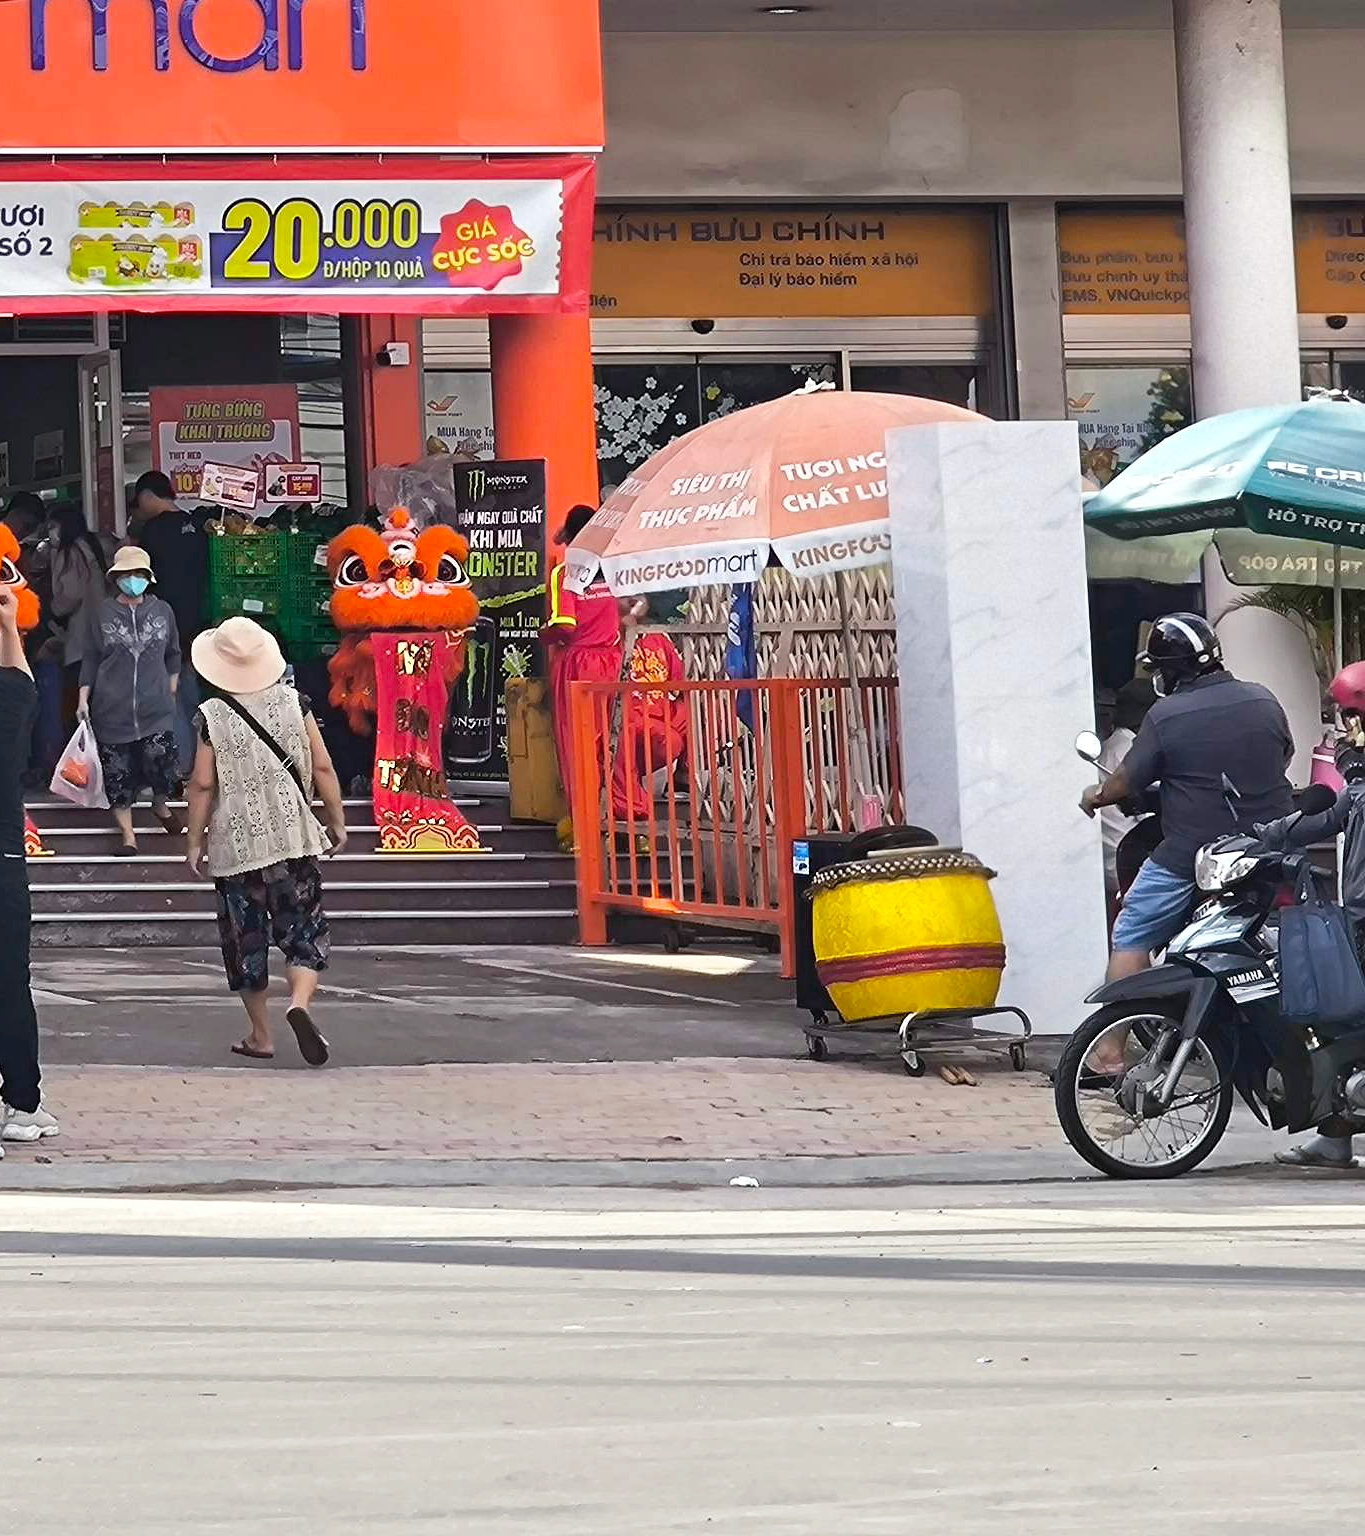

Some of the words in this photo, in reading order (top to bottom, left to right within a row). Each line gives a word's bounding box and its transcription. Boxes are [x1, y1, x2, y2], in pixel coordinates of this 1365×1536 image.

[222, 197, 422, 281] 20.000
[456, 214, 498, 241] GIÁ
[691, 218, 762, 242] BƯU
[772, 213, 885, 241] CHÍNH
[38, 237, 53, 256] 2
[432, 245, 482, 273] CỰC
[484, 236, 536, 263] SỐC
[324, 256, 372, 283] Đ/HỘP
[374, 260, 388, 278] 10
[394, 256, 424, 279] QUẢ
[670, 471, 718, 497] SIÊU
[718, 468, 752, 491] THỊ
[781, 459, 845, 482] TƯƠI
[782, 483, 850, 513] CHẤT
[476, 511, 501, 525] NGAY
[519, 505, 543, 524] CHẤT
[639, 510, 692, 532] THỰC
[695, 493, 758, 524] PHẨM
[470, 529, 494, 549] KHI
[497, 528, 523, 548] MUA
[1226, 969, 1265, 986] YAMAHA
